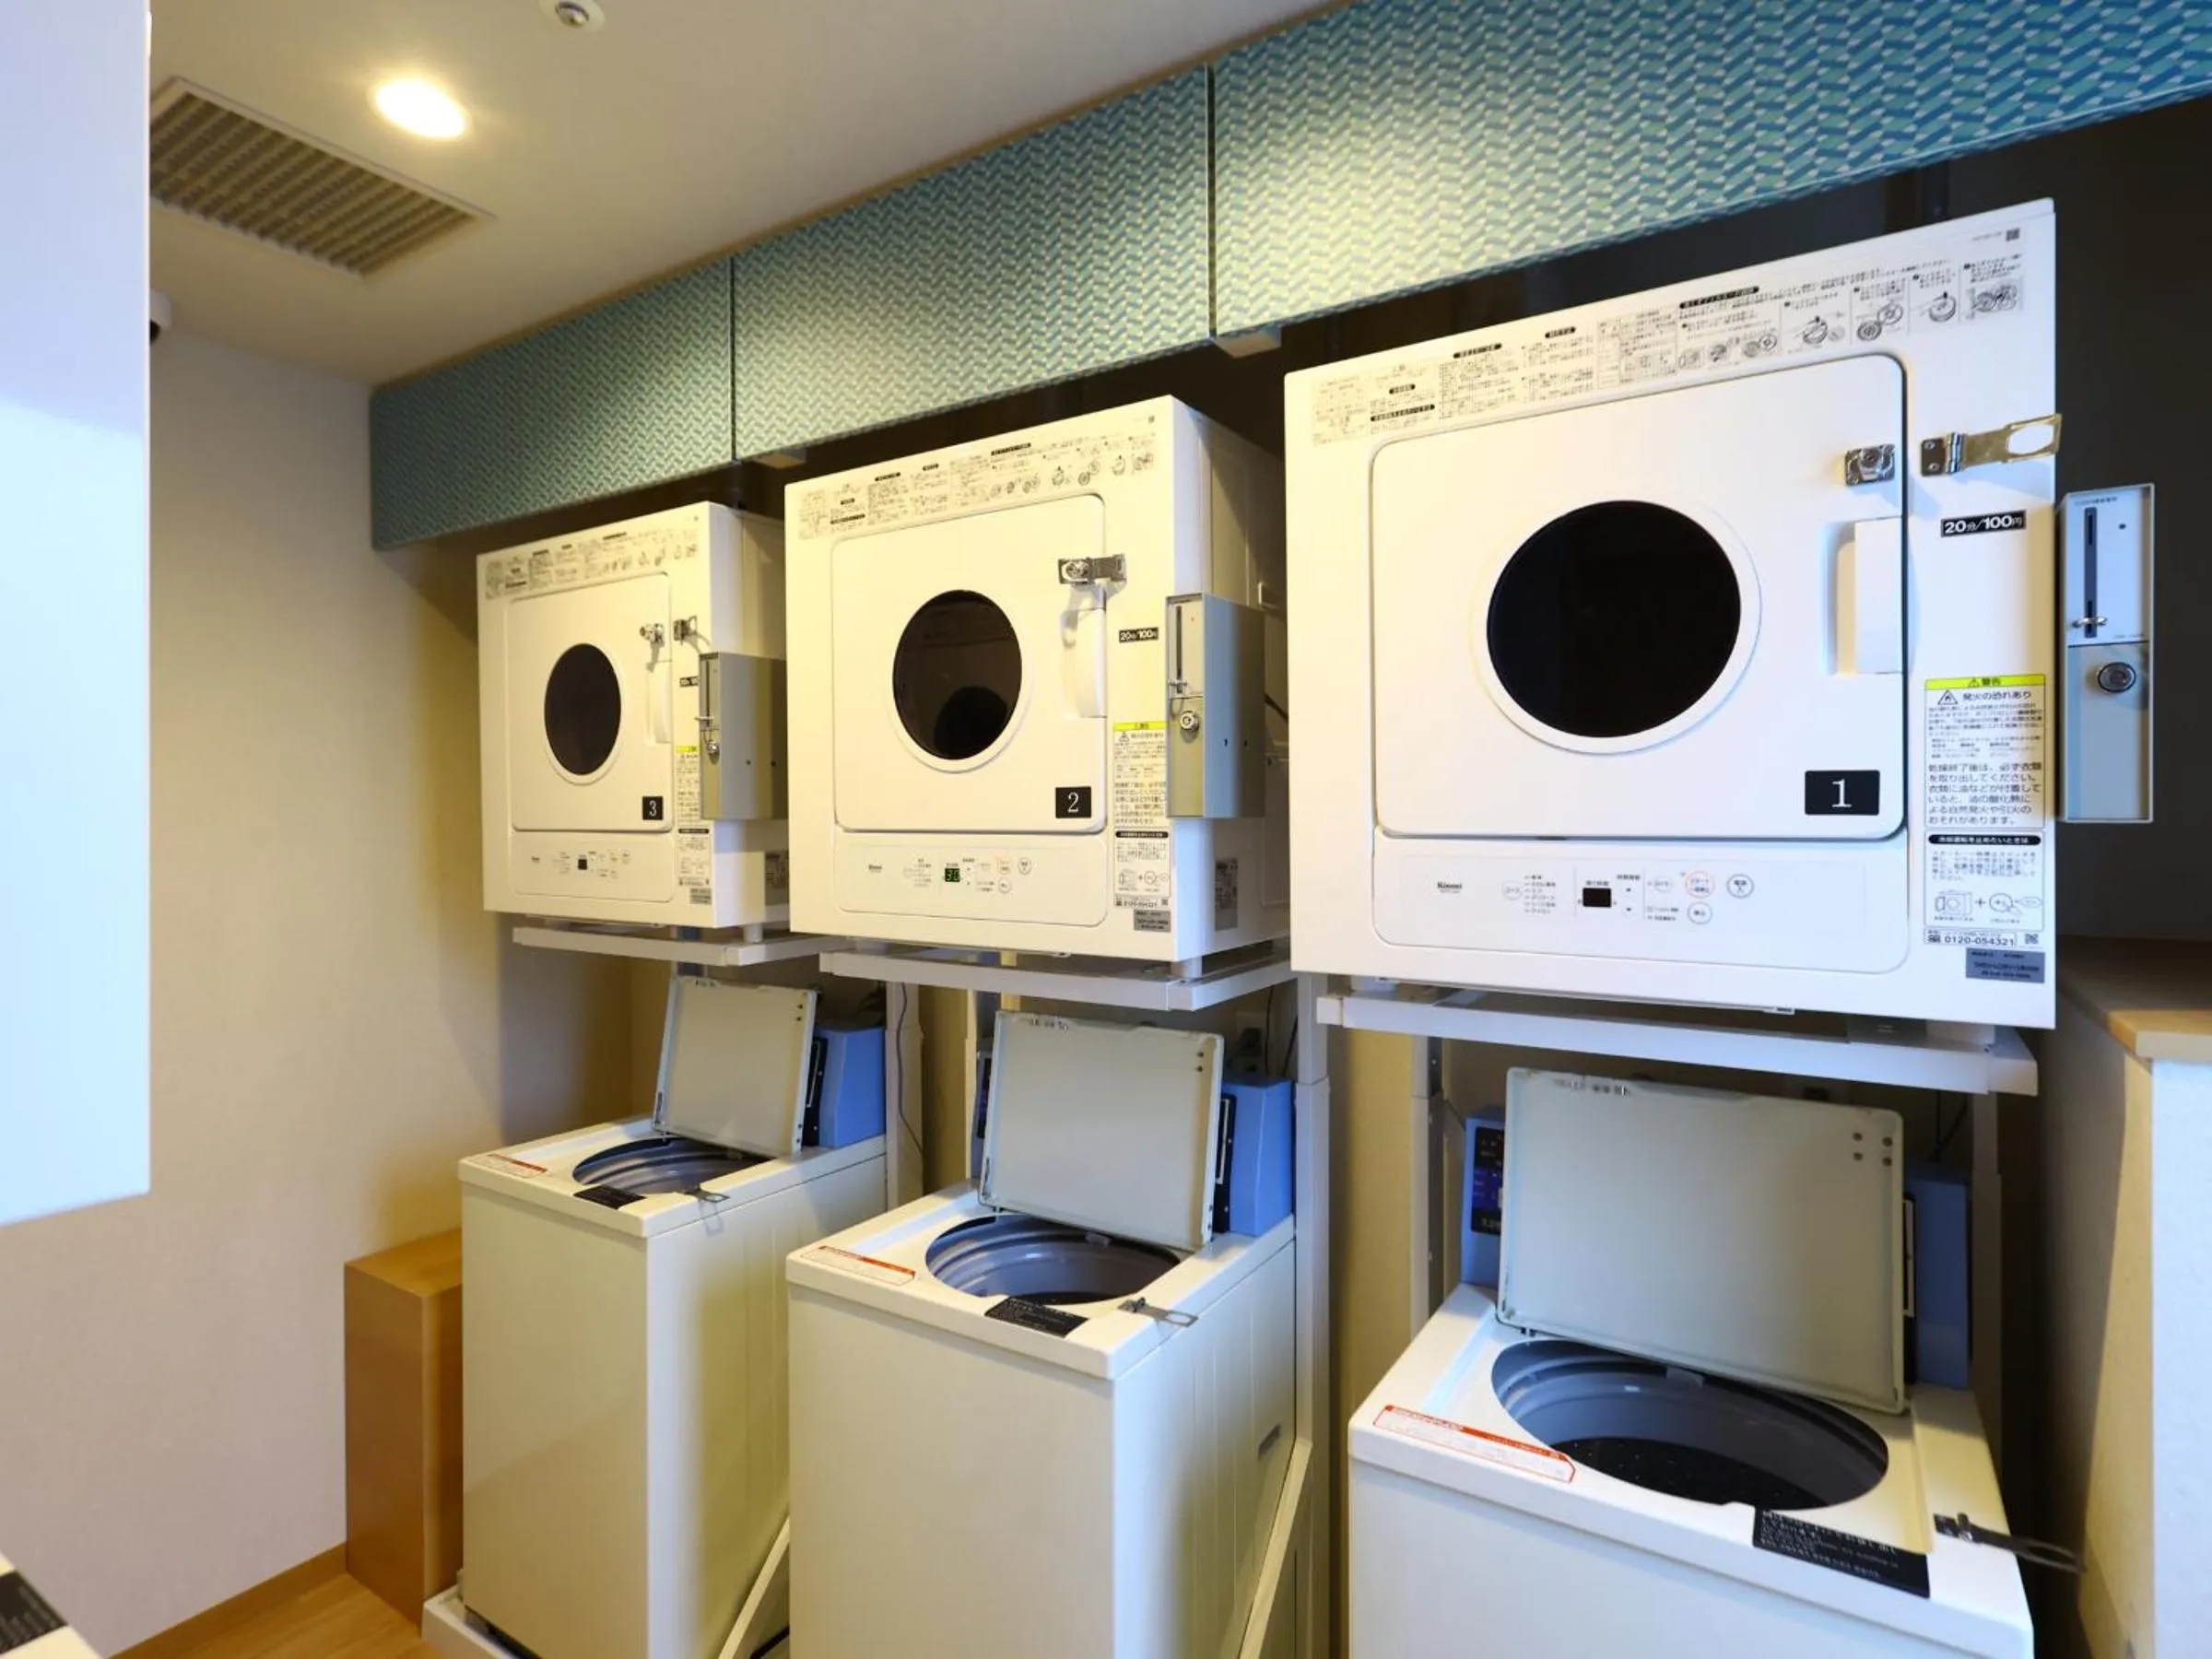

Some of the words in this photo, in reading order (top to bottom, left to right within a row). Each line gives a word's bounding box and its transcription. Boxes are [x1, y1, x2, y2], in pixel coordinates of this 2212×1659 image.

[1067, 792, 1079, 813] 2
[1831, 778, 1853, 808] 1
[649, 800, 657, 817] 3
[1945, 935, 2015, 947] 0120-054321
